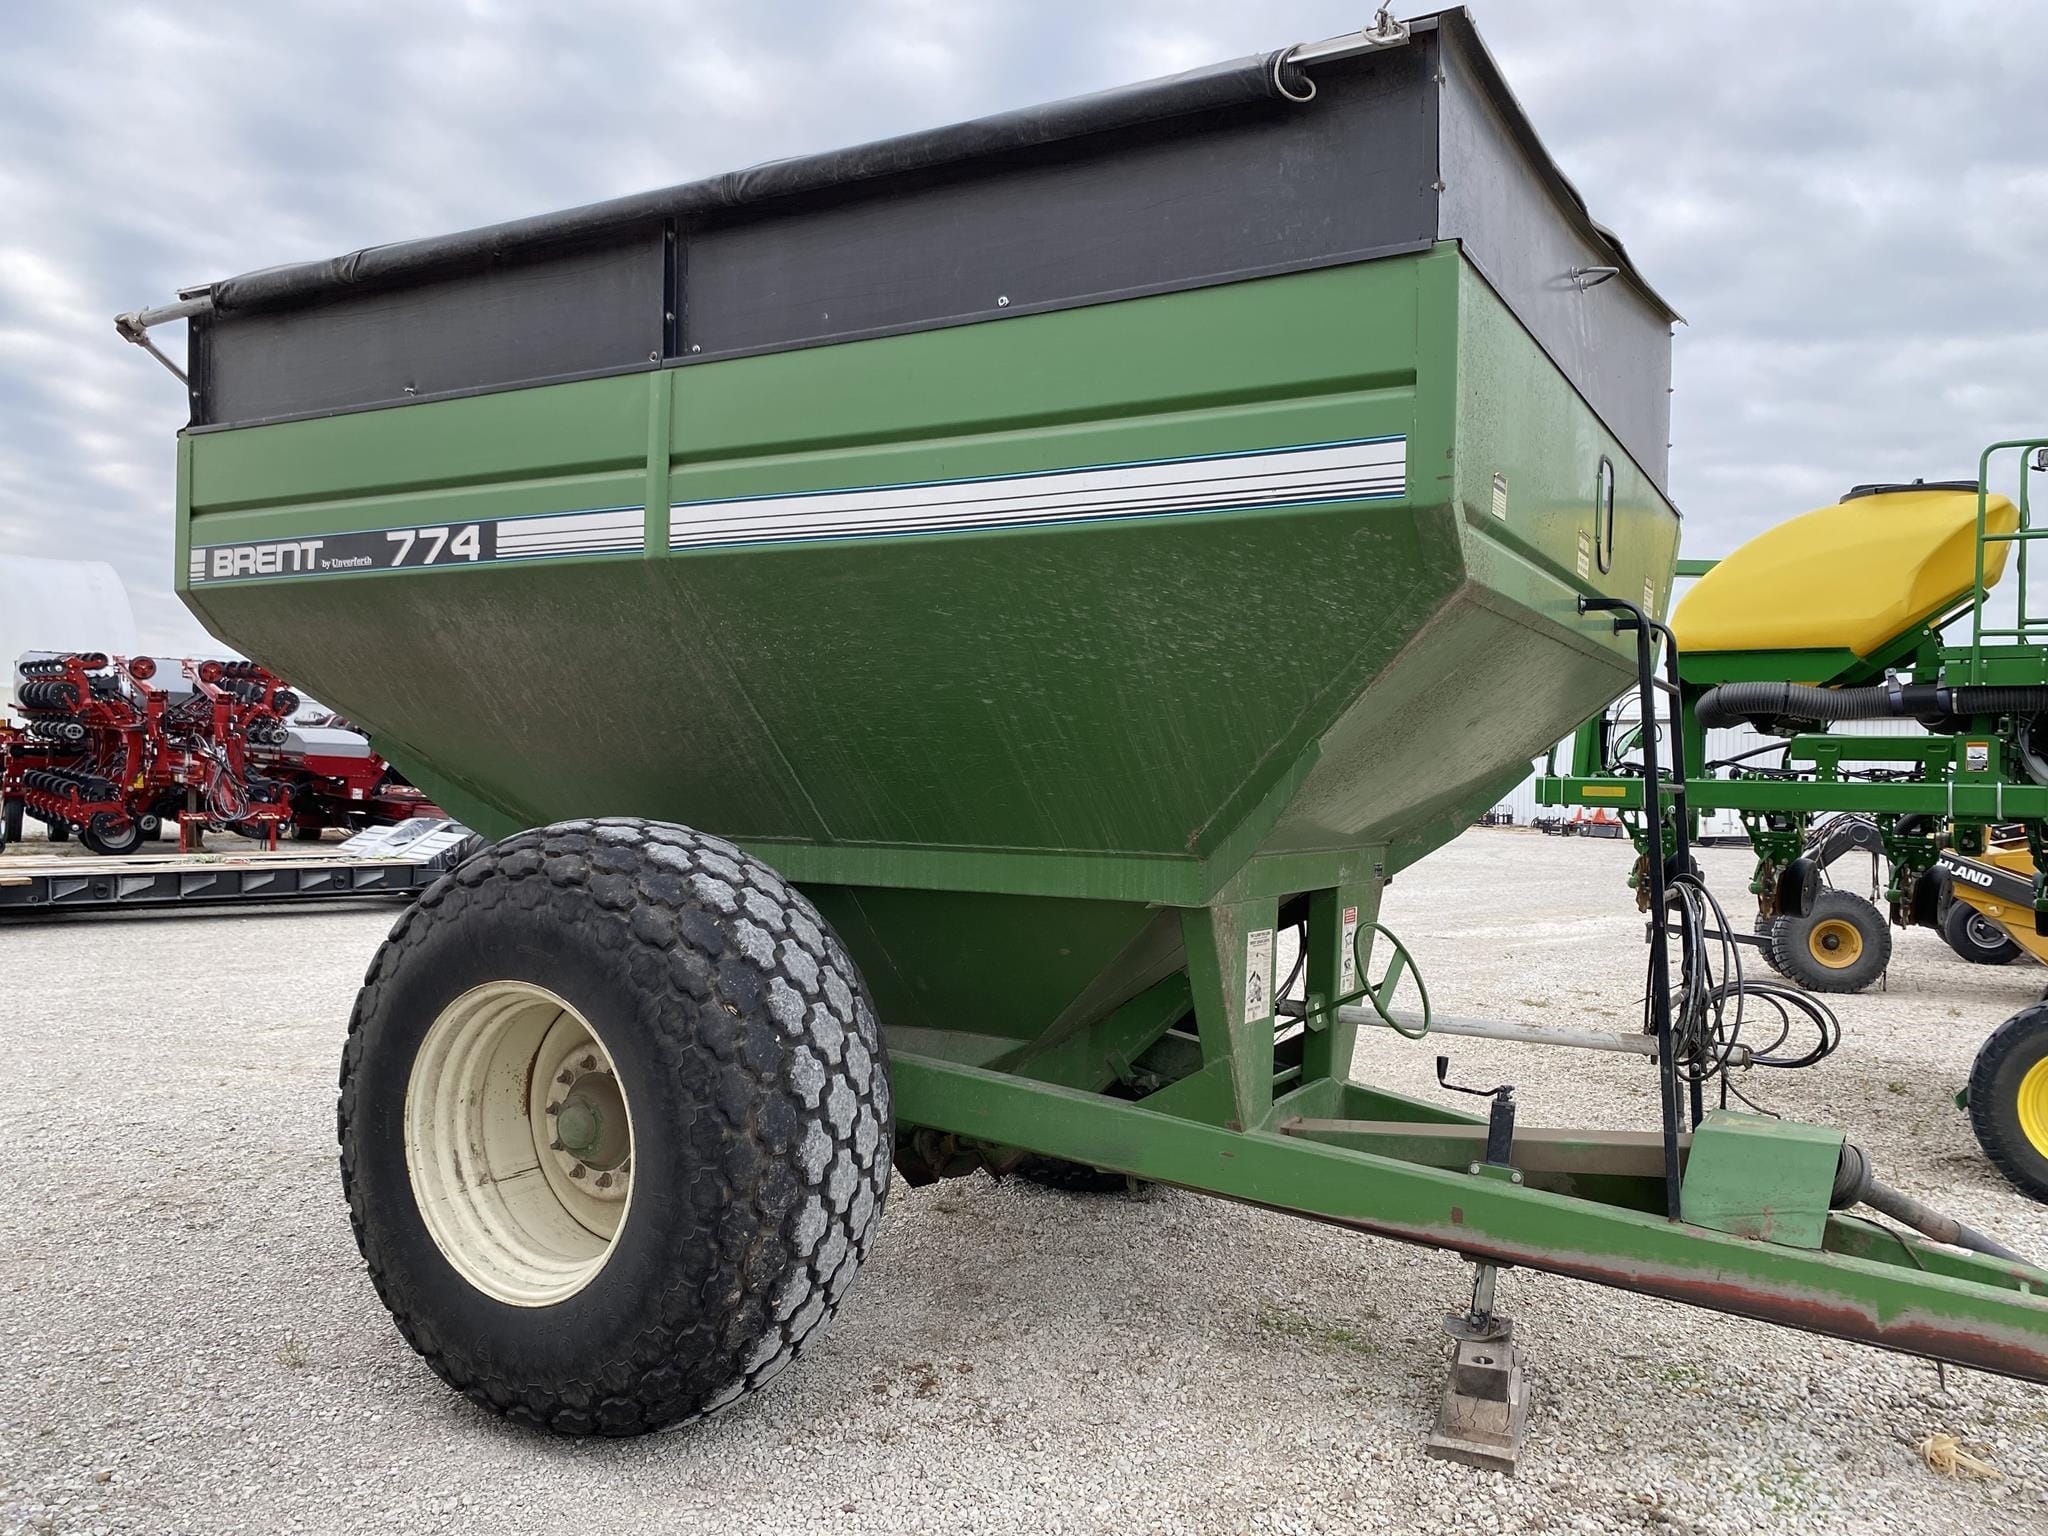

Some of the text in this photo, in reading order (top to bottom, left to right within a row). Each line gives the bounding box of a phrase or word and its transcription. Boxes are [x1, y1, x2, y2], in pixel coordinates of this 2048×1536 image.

[213, 524, 482, 578] BRENT by Unverferth 774
